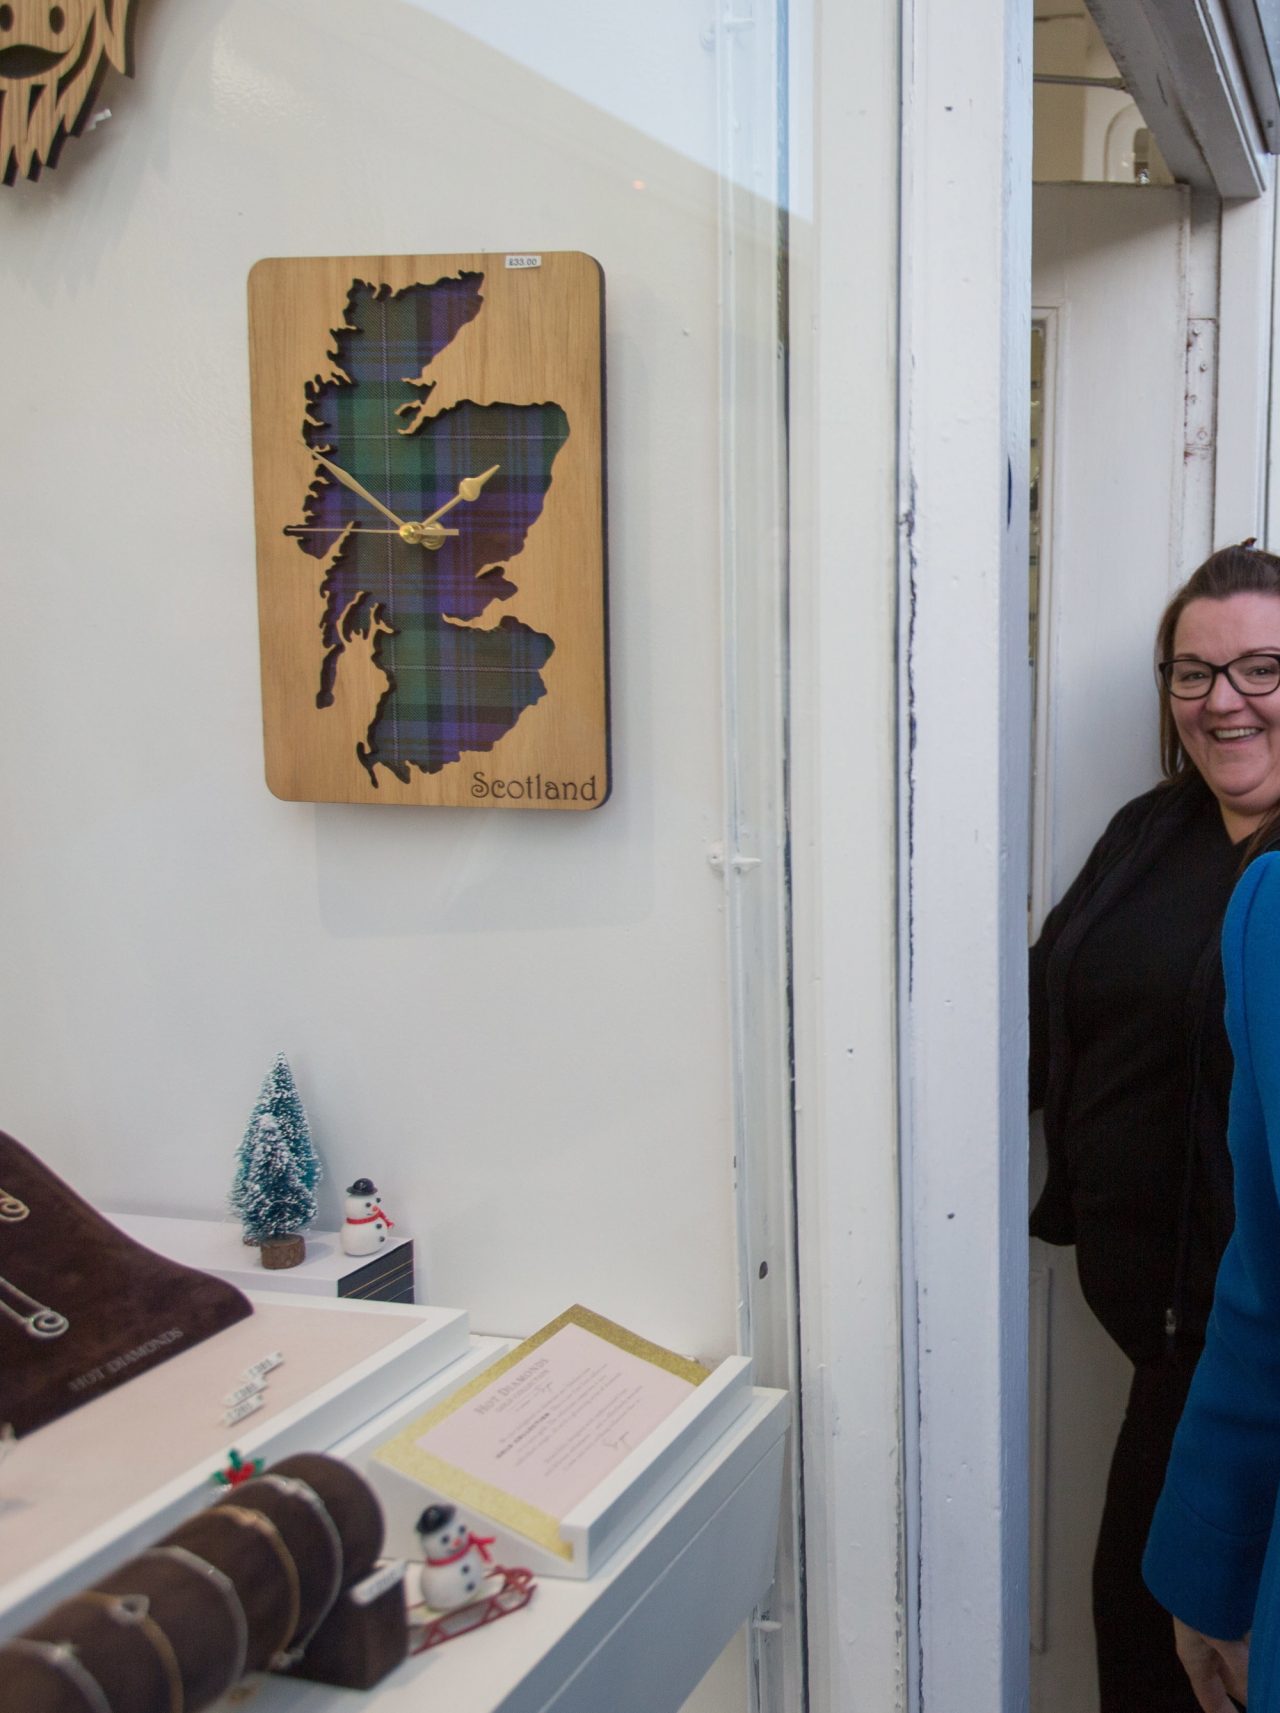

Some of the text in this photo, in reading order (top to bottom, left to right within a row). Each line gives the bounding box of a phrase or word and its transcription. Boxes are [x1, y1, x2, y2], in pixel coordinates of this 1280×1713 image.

[471, 771, 597, 801] Scotland
[67, 1327, 184, 1391] HOT DIAMONDS
